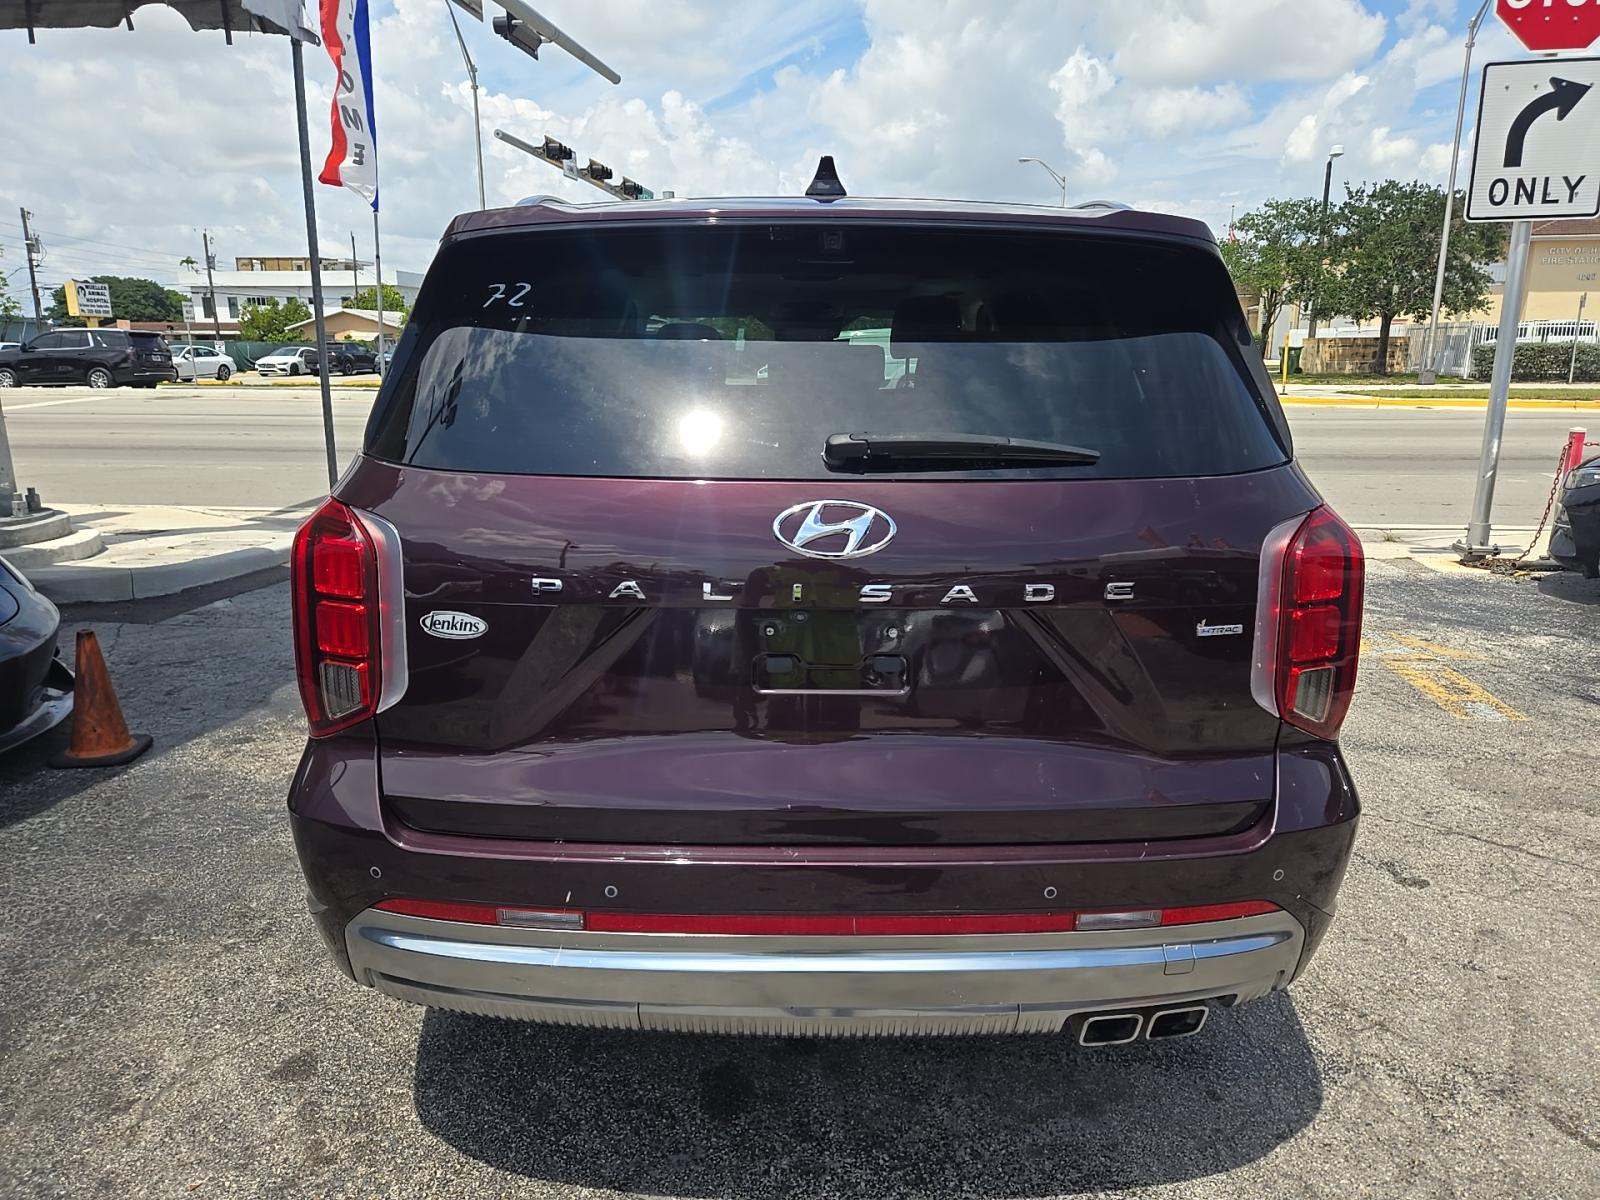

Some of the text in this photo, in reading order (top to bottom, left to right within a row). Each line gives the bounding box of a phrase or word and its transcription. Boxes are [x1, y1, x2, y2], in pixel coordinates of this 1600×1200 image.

[1488, 175, 1586, 207] ONLY
[1542, 256, 1564, 265] FIRE
[1549, 247, 1571, 255] CITY
[483, 282, 531, 308] 72
[531, 577, 1136, 604] PALISADE
[427, 614, 480, 633] Jenkins
